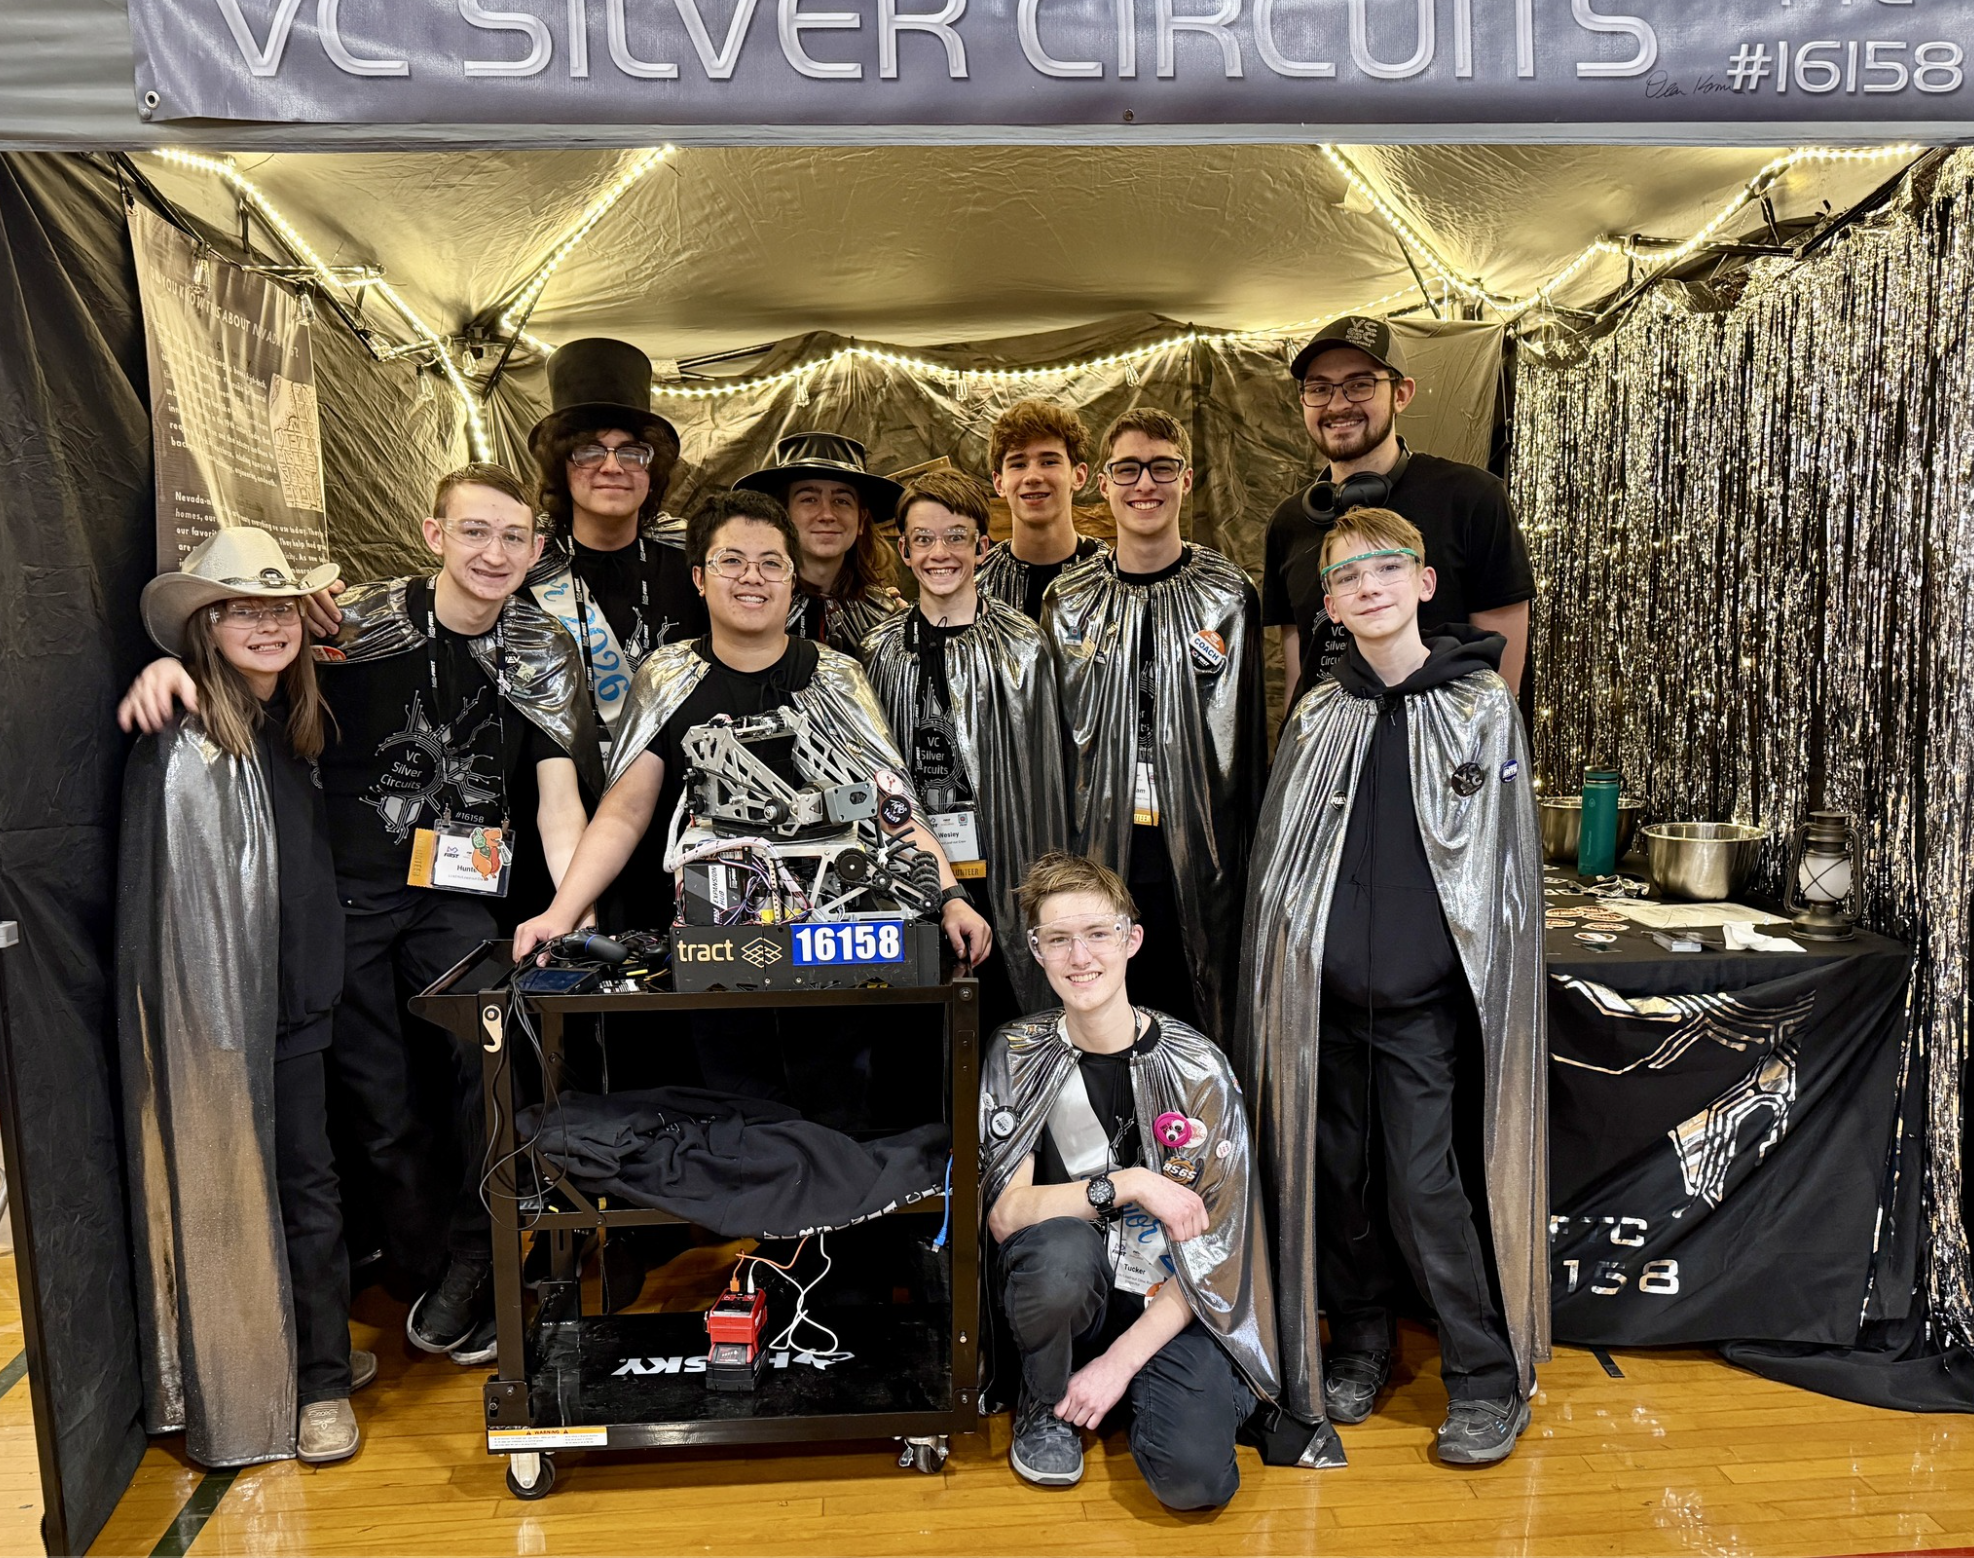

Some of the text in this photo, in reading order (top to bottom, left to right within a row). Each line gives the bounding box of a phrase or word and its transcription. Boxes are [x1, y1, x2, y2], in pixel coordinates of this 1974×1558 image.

[225, 0, 1659, 80] VC SILVER CIRCUITS
[1726, 40, 1964, 93] #16158
[162, 276, 177, 296] YOU
[179, 285, 207, 309] KOW
[222, 310, 251, 333] ABOUT
[175, 508, 203, 521] homes,
[1331, 626, 1345, 637] VC
[1194, 638, 1220, 661] COACH
[1321, 655, 1342, 666] Circu
[927, 736, 941, 748] VC
[406, 749, 421, 764] VC
[391, 761, 423, 778] Silver
[923, 764, 949, 775] rcuits
[380, 773, 422, 790] Circuits
[455, 811, 485, 823] #16158
[711, 866, 719, 904] EXPANSION
[718, 890, 726, 906] HUB
[677, 939, 734, 962] tract
[795, 925, 900, 962] 16158
[1124, 1263, 1146, 1275] Tucker
[1562, 1259, 1680, 1295] 158
[611, 1350, 790, 1376] HSKY
